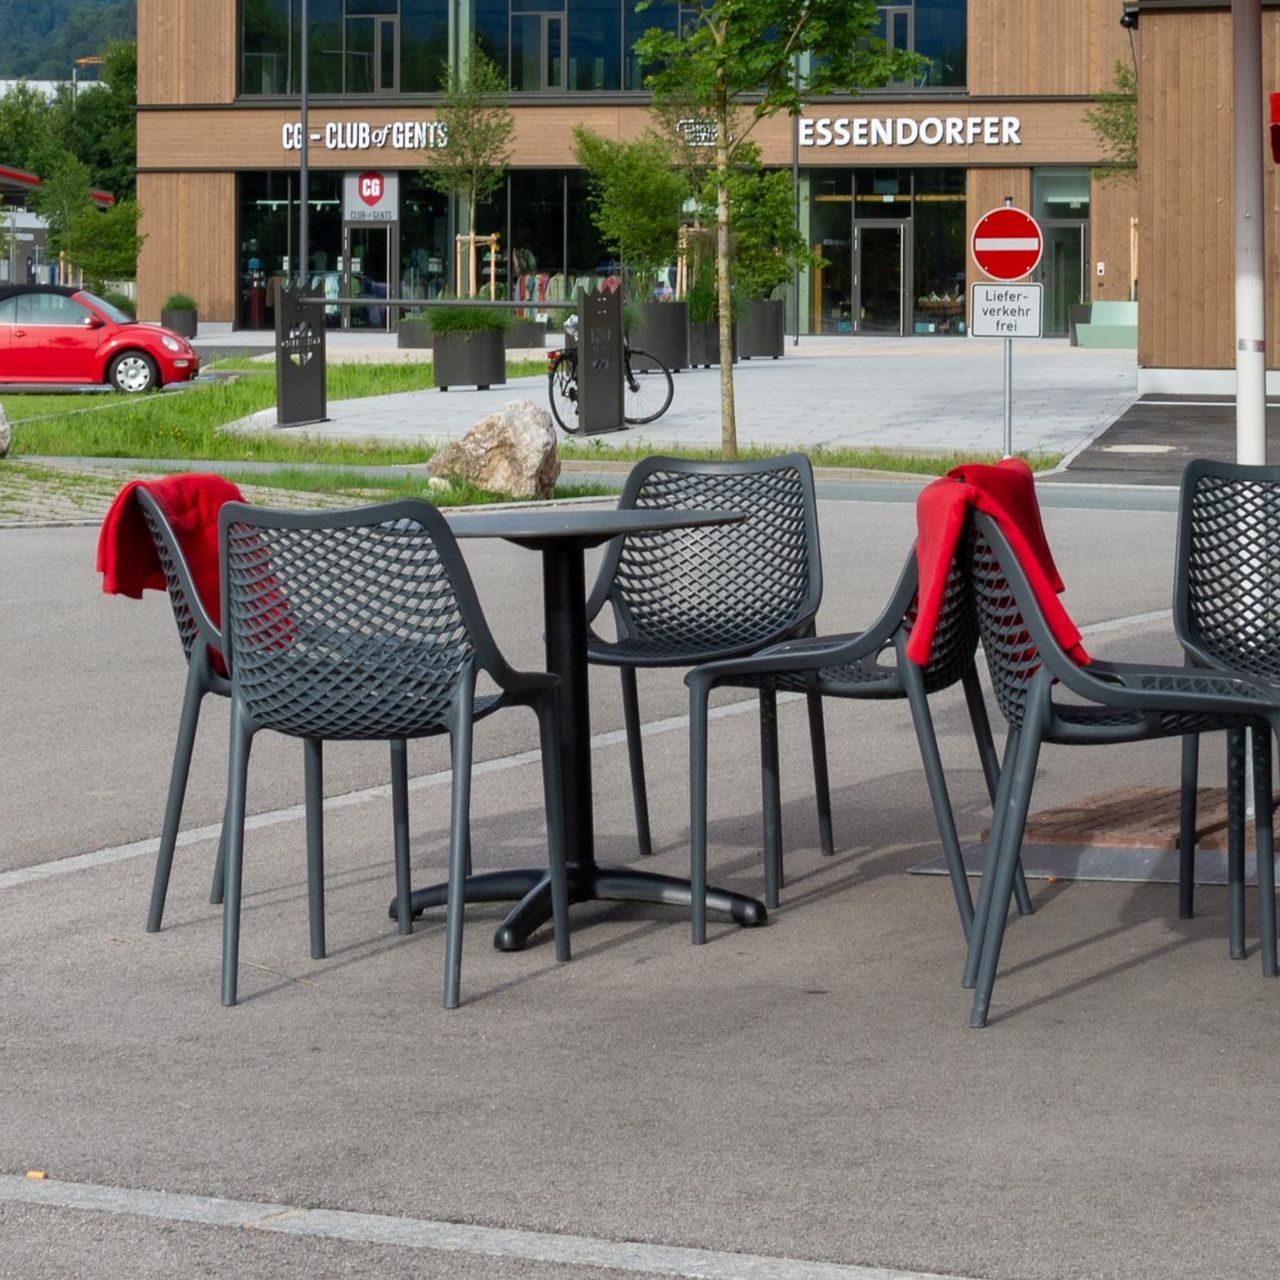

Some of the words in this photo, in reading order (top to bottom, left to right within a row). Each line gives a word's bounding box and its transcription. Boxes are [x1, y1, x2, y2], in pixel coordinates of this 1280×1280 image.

[325, 122, 370, 149] CLUB
[371, 123, 392, 148] of
[392, 121, 449, 149] GENTS
[799, 116, 1022, 146] ESSENDORFER
[362, 179, 380, 197] CG
[985, 290, 1029, 302] Liefer-
[982, 305, 1032, 317] verkehr
[996, 320, 1017, 332] frei
